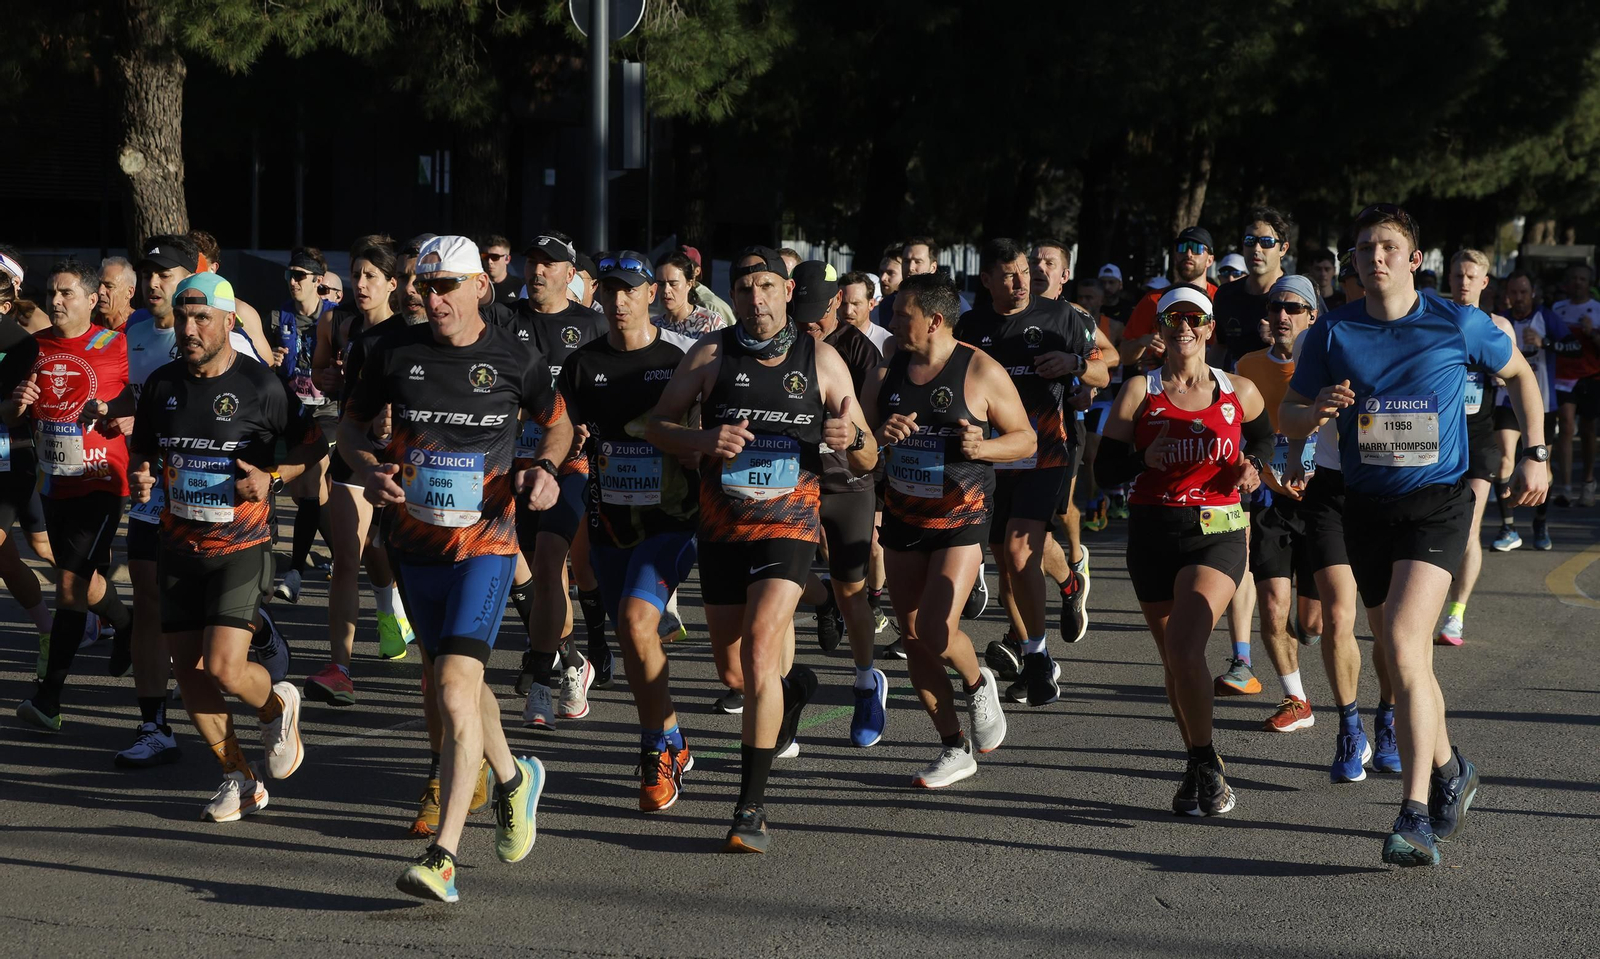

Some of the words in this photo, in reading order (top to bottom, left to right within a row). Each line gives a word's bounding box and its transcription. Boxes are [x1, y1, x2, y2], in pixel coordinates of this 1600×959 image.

[1385, 400, 1429, 410] ZURICH
[399, 408, 509, 426] JARTIBLES
[715, 408, 815, 425] JARTIBLES
[45, 424, 76, 434] ZURICH
[1384, 421, 1413, 431] 11958
[157, 437, 252, 452] ARTIBLES
[749, 439, 792, 449] ZURICH
[901, 438, 937, 449] ZURICH
[1359, 442, 1388, 451] HARRY
[1391, 441, 1438, 450] THOMPSON
[616, 446, 653, 455] ZURICH
[45, 451, 66, 463] MAO
[429, 455, 475, 468] ZURICH
[187, 459, 227, 471] ZURICH
[617, 464, 637, 473] 6474
[748, 471, 772, 486] ELY
[891, 464, 931, 482] VICTOR
[429, 477, 453, 489] 5696
[600, 475, 660, 490] JONATHAN
[172, 486, 229, 506] BANDERA
[424, 491, 456, 508] ANA
